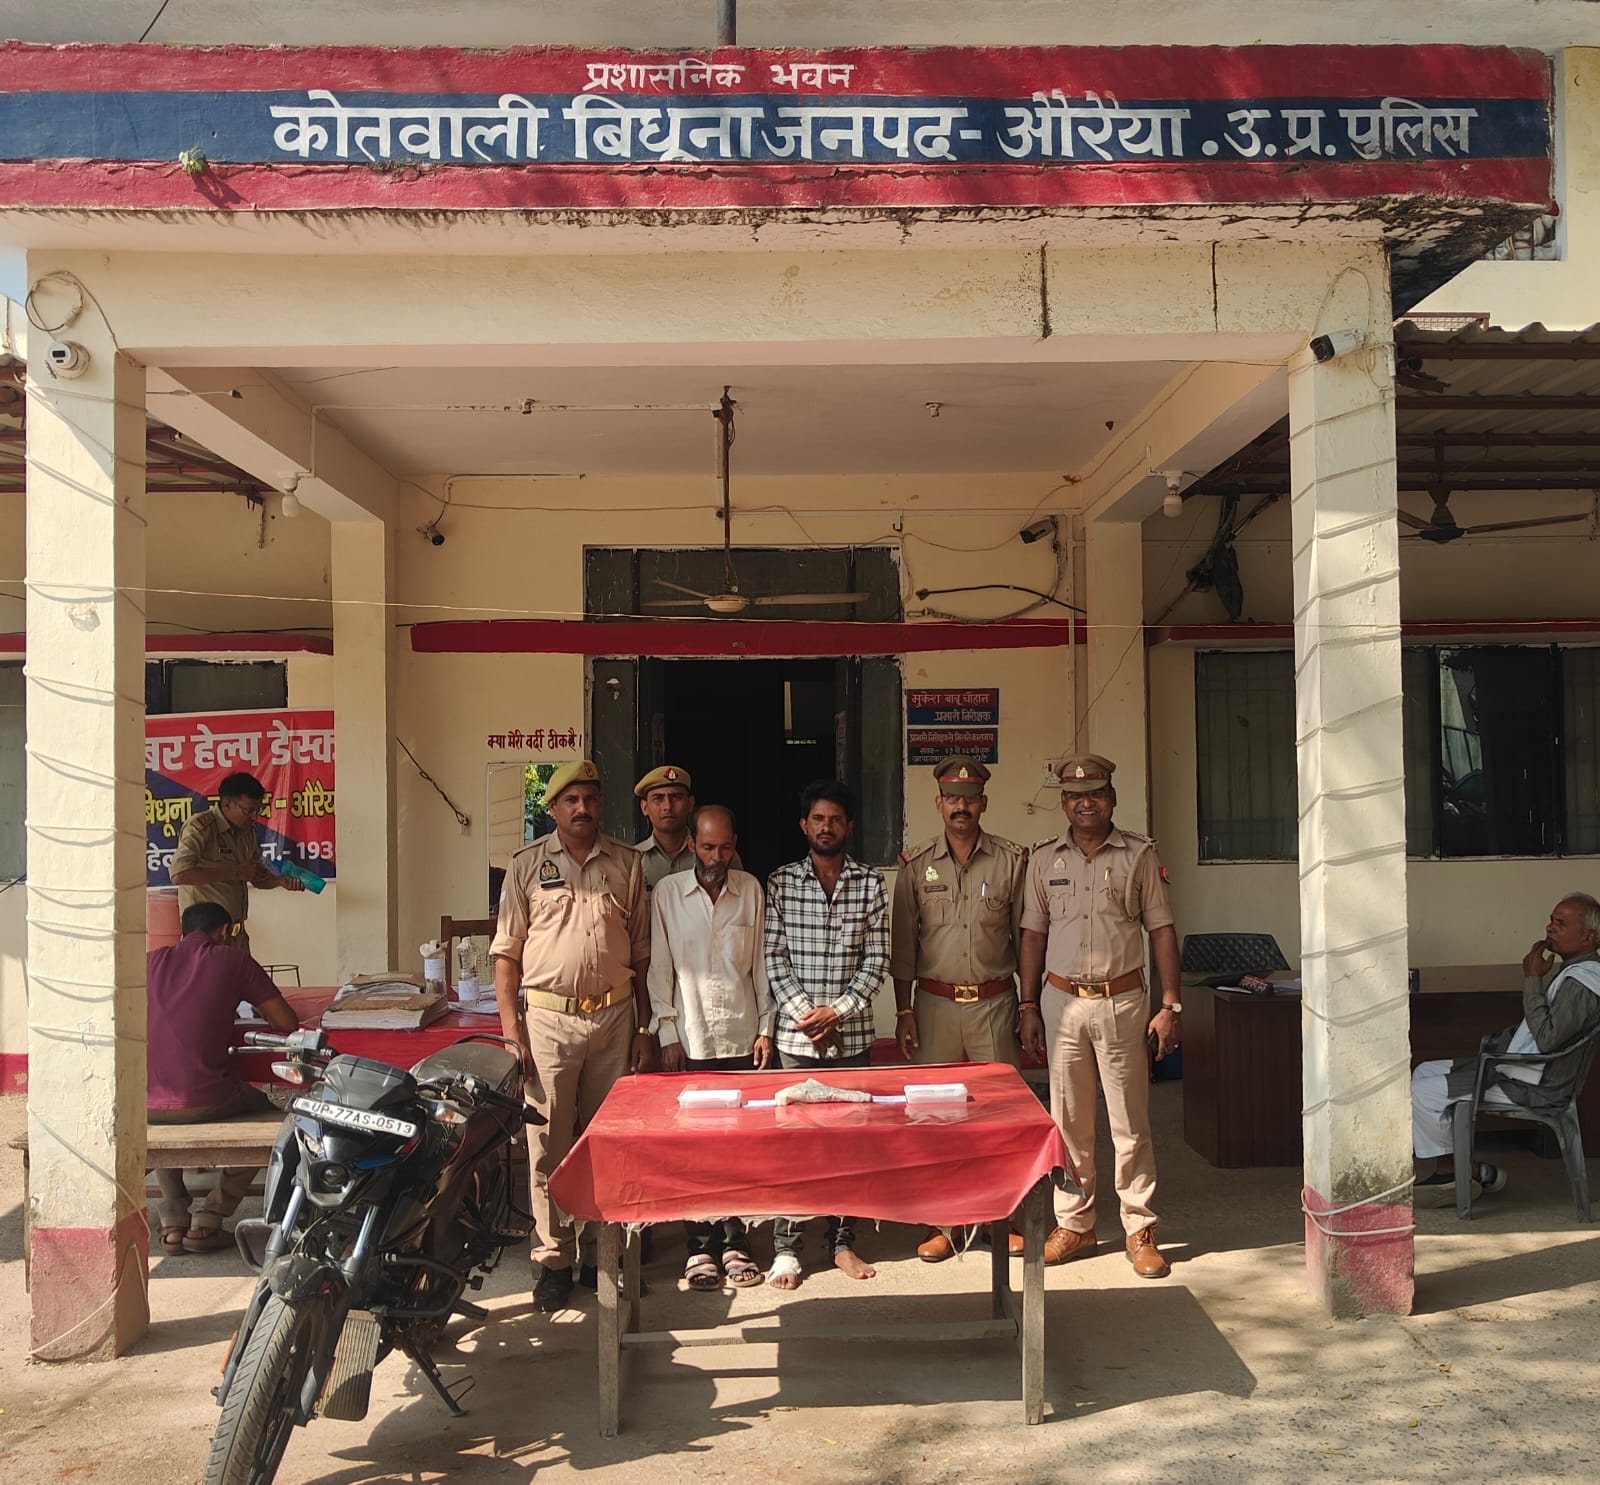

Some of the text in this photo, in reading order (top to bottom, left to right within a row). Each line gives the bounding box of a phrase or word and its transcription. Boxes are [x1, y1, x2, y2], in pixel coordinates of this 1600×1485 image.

[581, 59, 855, 93] प्रशासनिक भवन
[270, 89, 549, 162] कोतवाली
[562, 94, 765, 162] बिधूना
[997, 88, 1191, 161] औरैया
[1338, 97, 1478, 160] पुलिस
[191, 724, 262, 769] हेल्प
[487, 734, 506, 750] क्या
[507, 728, 525, 750] मेरी
